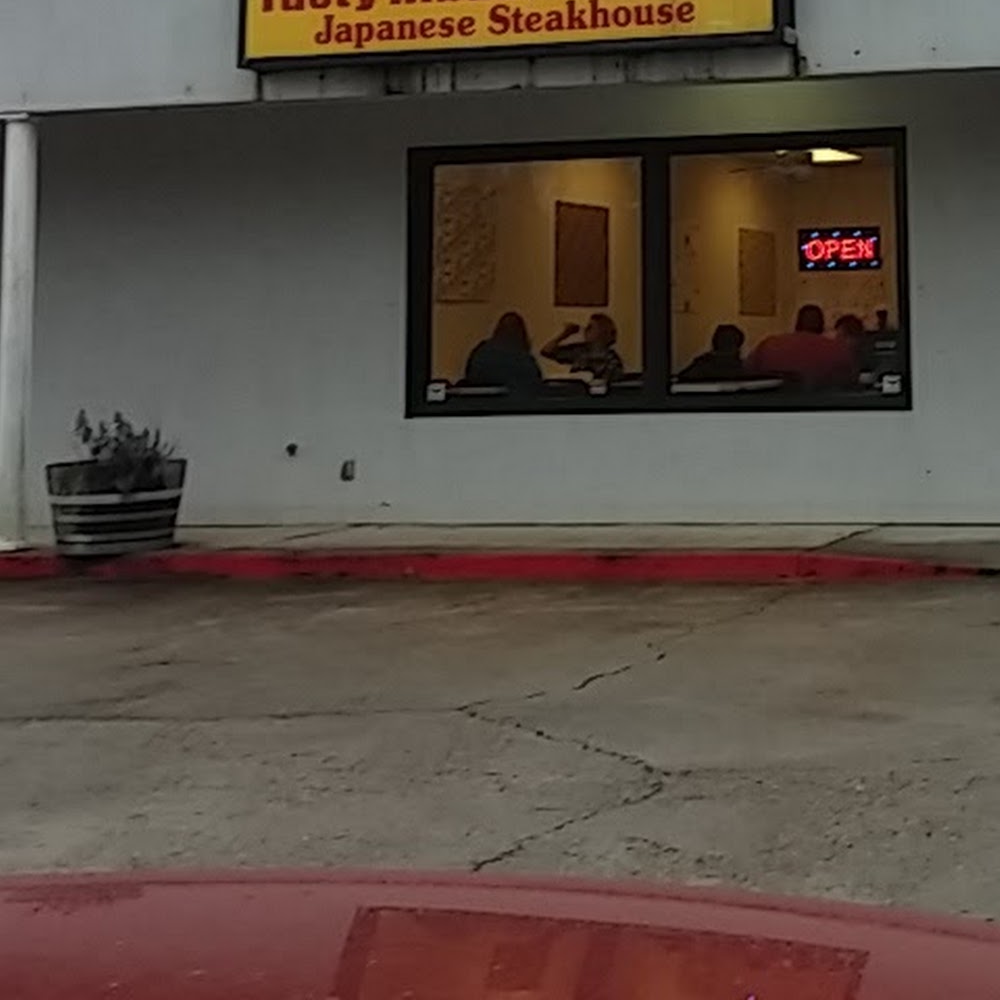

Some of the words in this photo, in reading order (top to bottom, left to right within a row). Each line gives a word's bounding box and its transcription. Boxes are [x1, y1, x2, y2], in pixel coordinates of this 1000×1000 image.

[314, 14, 476, 48] Japanese
[487, 0, 695, 35] Steakhouse
[804, 238, 875, 261] OPEN
